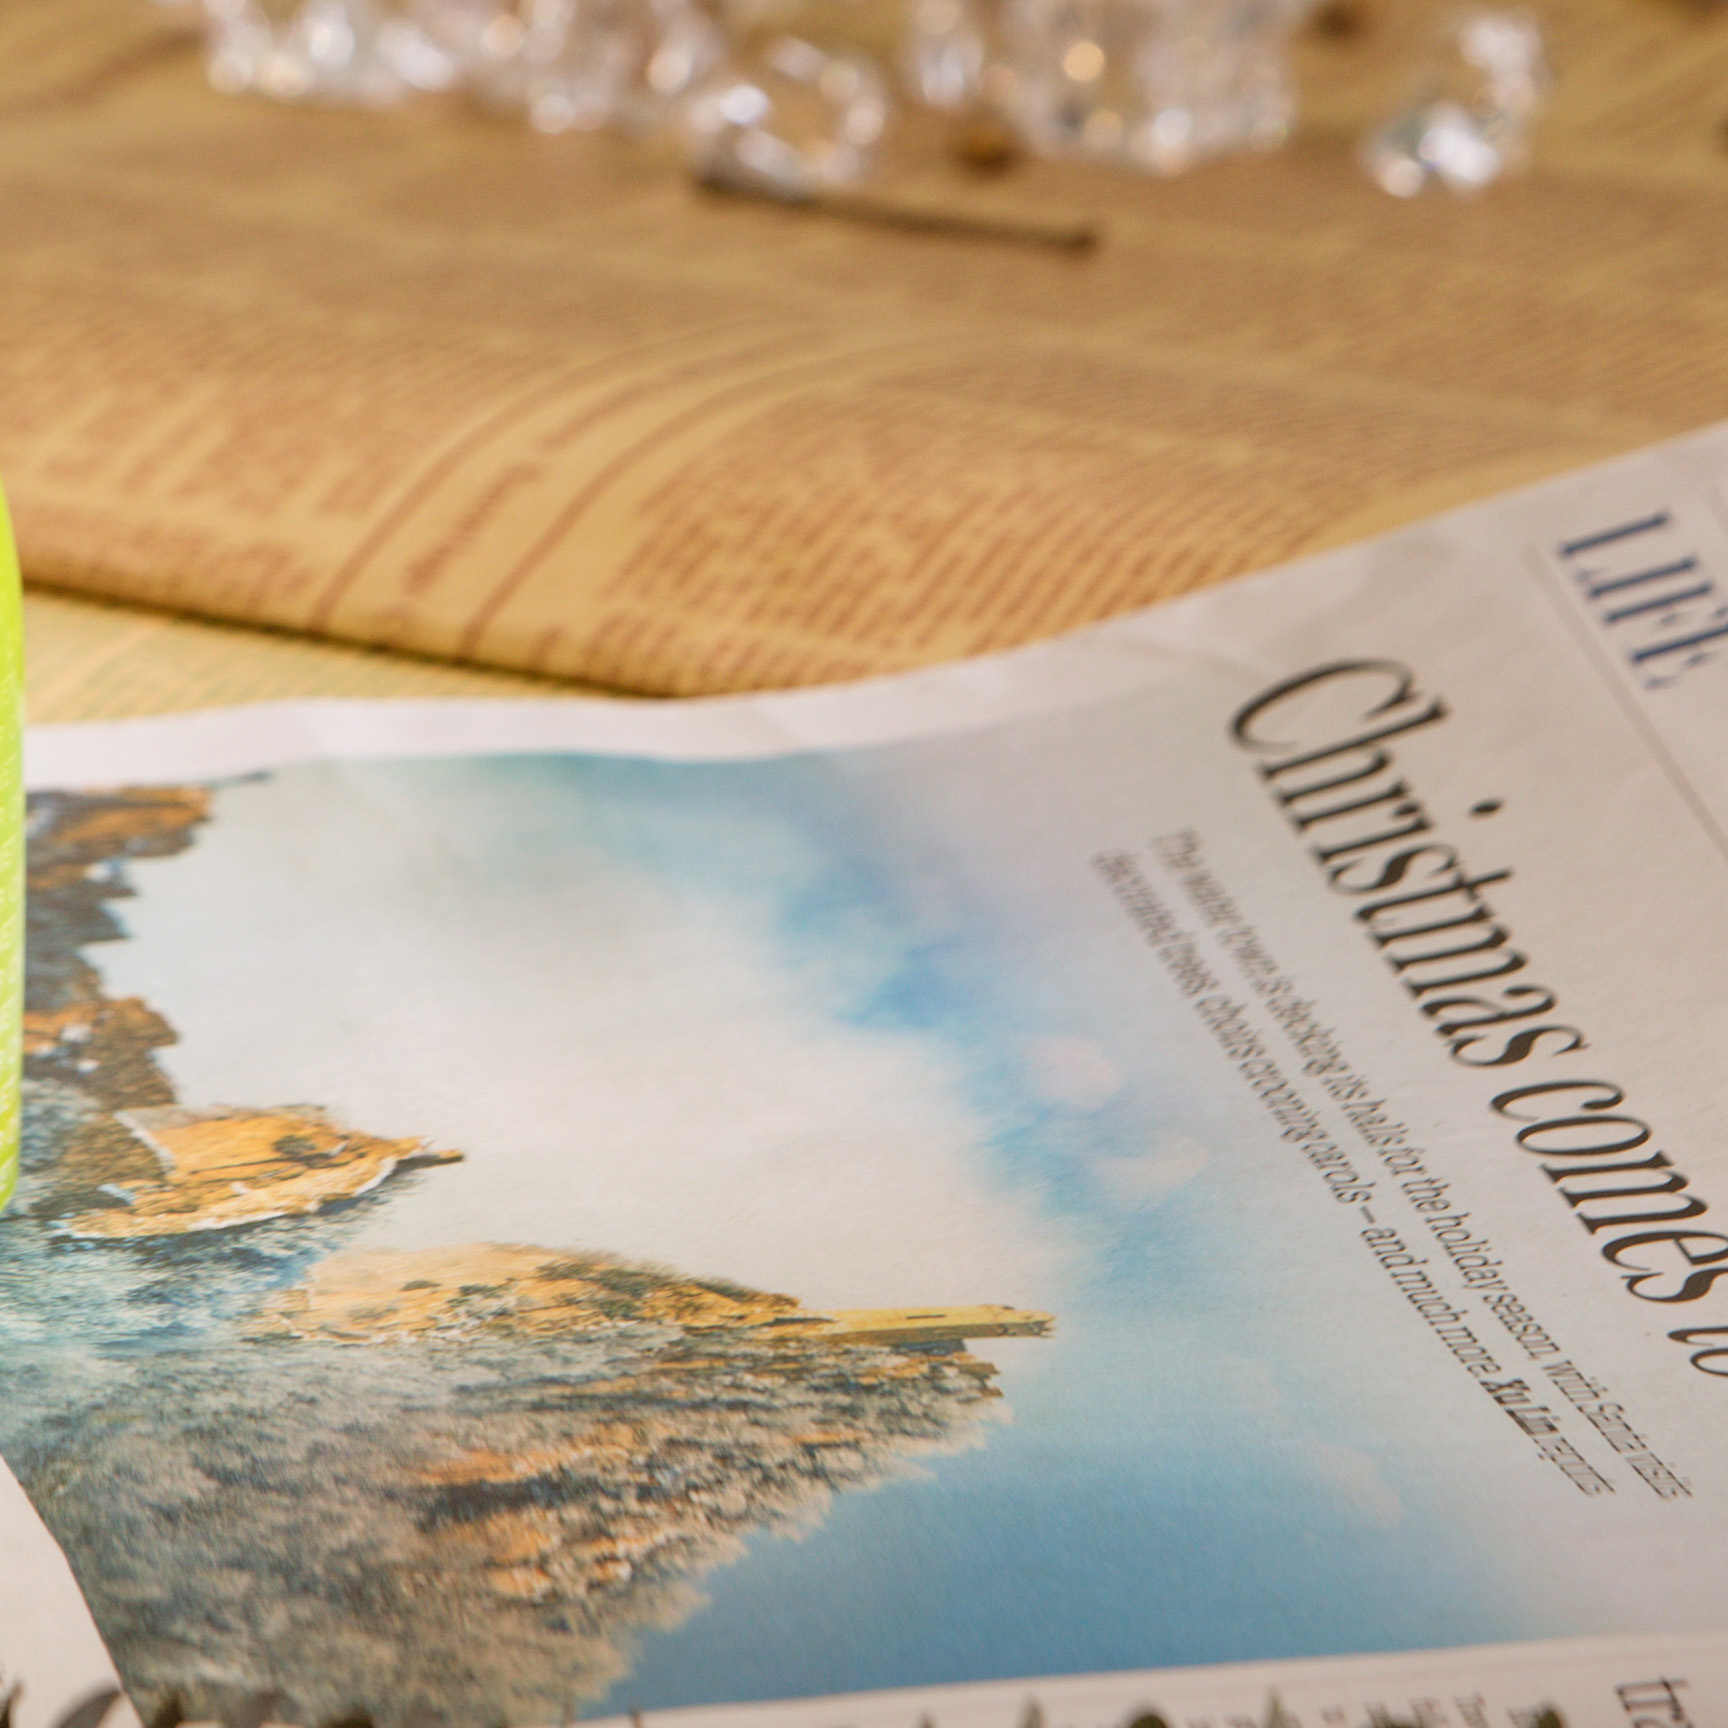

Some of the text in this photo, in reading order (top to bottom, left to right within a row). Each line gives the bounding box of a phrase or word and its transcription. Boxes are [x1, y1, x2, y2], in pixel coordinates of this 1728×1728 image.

[1227, 657, 1728, 1304] Christmas comes
[1376, 1147, 1426, 1177] for
[1401, 1177, 1452, 1213] the
[1360, 1227, 1429, 1271] and
[1423, 1212, 1508, 1291] holiday
[1390, 1270, 1469, 1326] much
[1541, 1359, 1609, 1405] with
